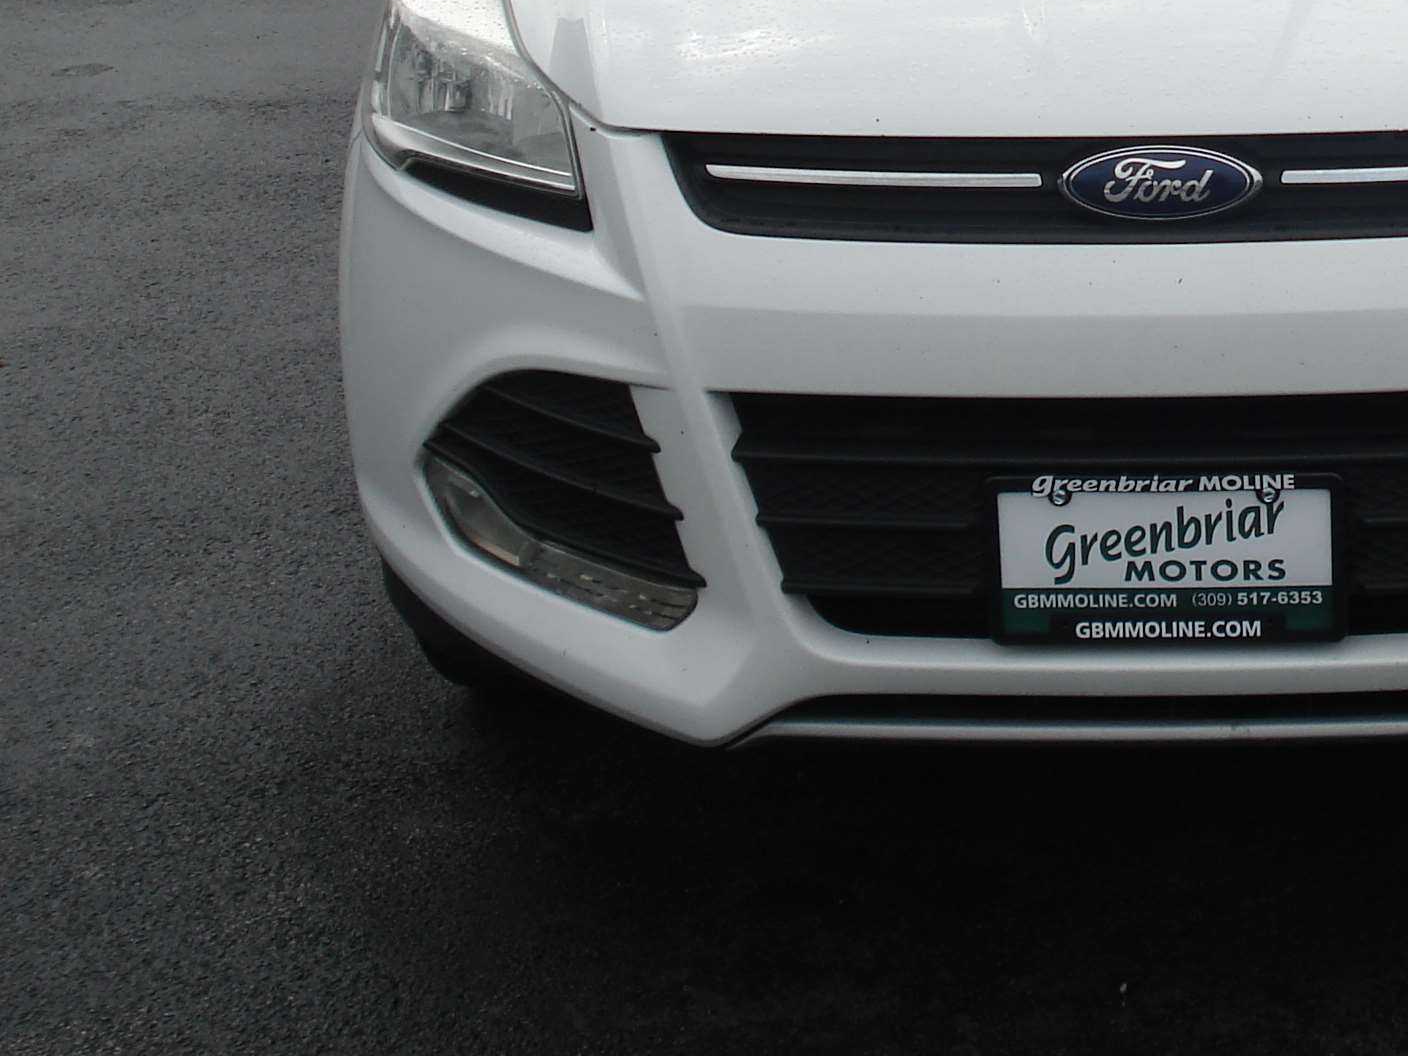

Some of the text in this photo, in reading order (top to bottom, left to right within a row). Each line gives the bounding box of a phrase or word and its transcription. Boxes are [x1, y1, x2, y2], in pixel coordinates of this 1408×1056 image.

[1104, 157, 1214, 203] Ford
[1199, 474, 1295, 491] MOLINE
[1045, 498, 1285, 585] Greenbriar
[1124, 559, 1287, 582] MOTORS
[1014, 590, 1324, 609] GBMMOLINE.COM (309) 517-6353
[1075, 620, 1262, 639] GBMMOLINE.COM
